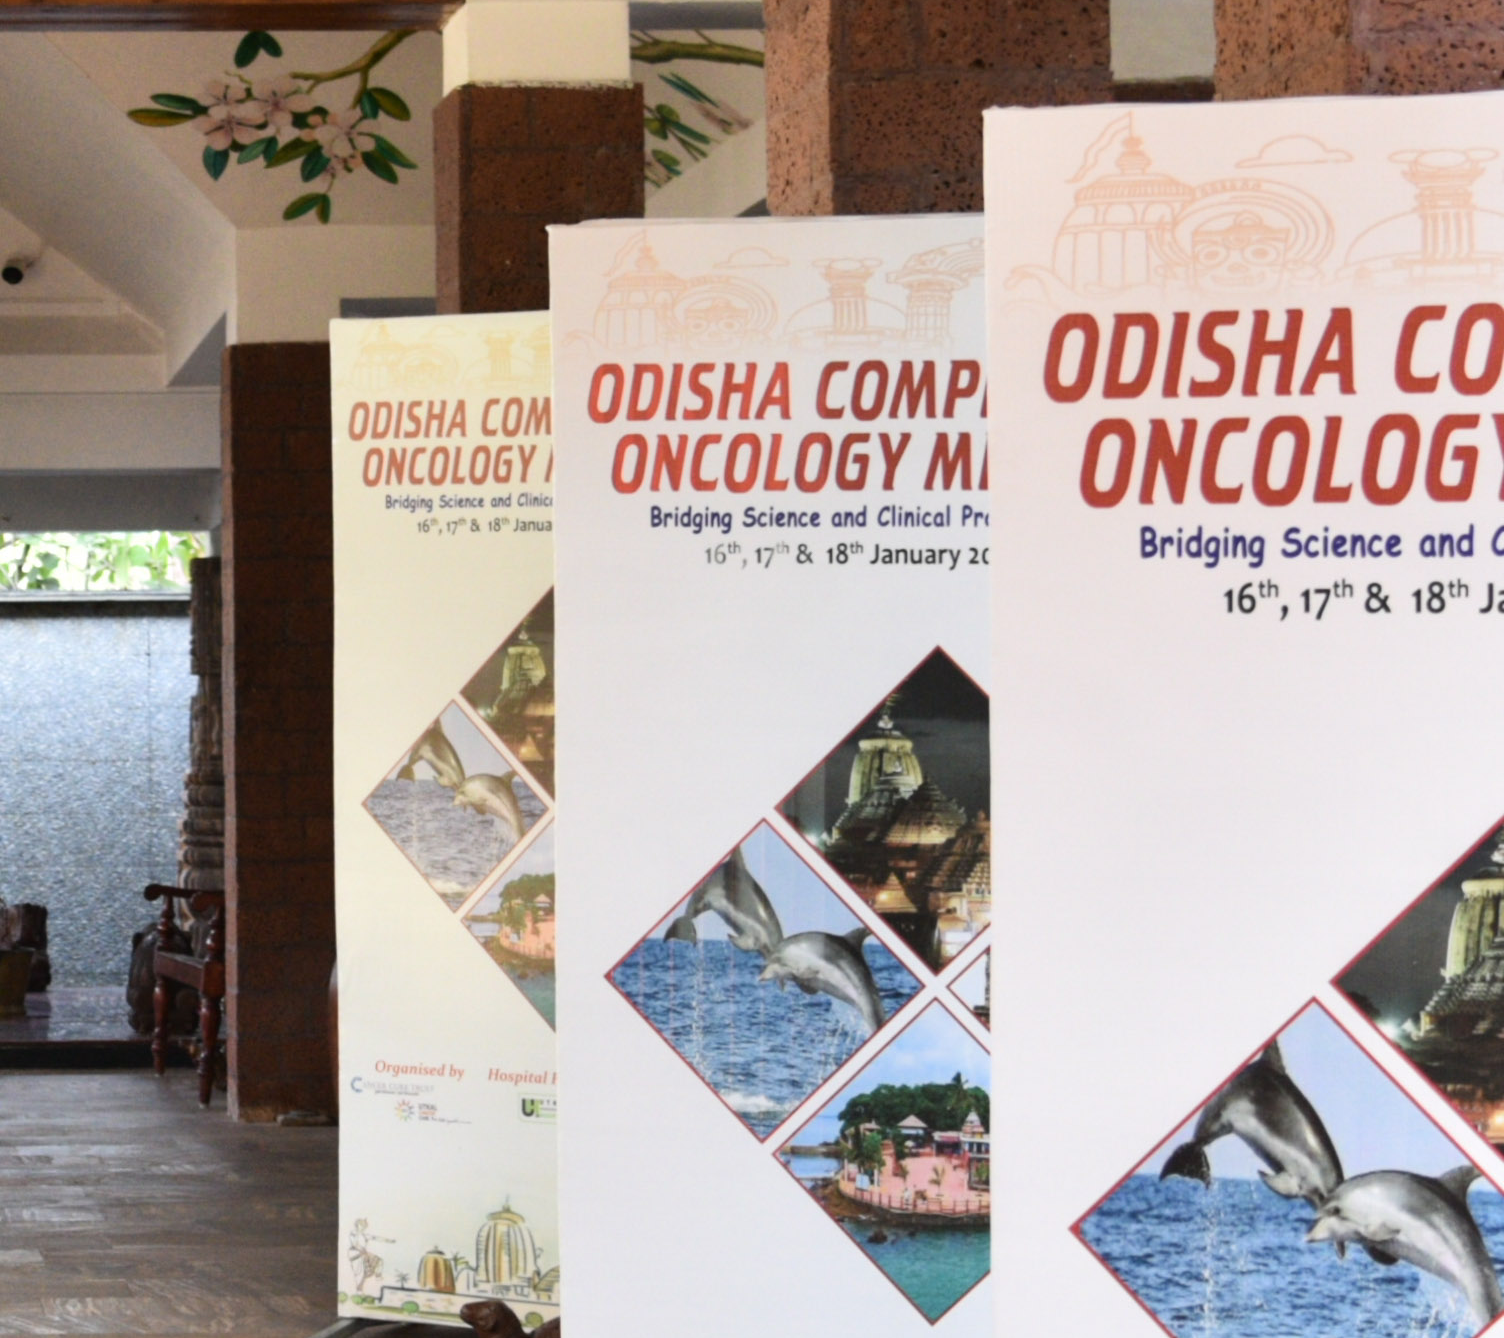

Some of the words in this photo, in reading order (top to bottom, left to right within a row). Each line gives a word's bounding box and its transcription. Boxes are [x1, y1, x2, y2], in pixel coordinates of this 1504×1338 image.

[1044, 307, 1356, 403] ODISHA
[588, 362, 791, 424] ODISHA
[349, 399, 467, 441] ODISHA
[363, 445, 537, 487] ONCOLOGY
[611, 432, 912, 494] ONCOLOGY
[385, 494, 433, 513] Bridging
[439, 494, 484, 509] Science
[491, 493, 511, 508] and
[517, 493, 552, 507] Clinic
[651, 506, 732, 534] Bridging
[743, 507, 820, 527] Science
[831, 506, 867, 527] and
[877, 505, 950, 527] Clinical
[470, 518, 480, 532] &
[513, 518, 552, 532] Janua
[796, 544, 813, 564] &
[870, 544, 961, 570] January
[1140, 526, 1265, 568] Bridging
[1281, 527, 1402, 558] Science
[1419, 524, 1474, 557] and
[1301, 579, 1353, 620] 17th
[1365, 583, 1391, 613] &
[1412, 579, 1468, 614] 18th
[375, 1061, 446, 1077] Organised
[449, 1064, 464, 1081] by
[488, 1069, 548, 1086] Hospital
